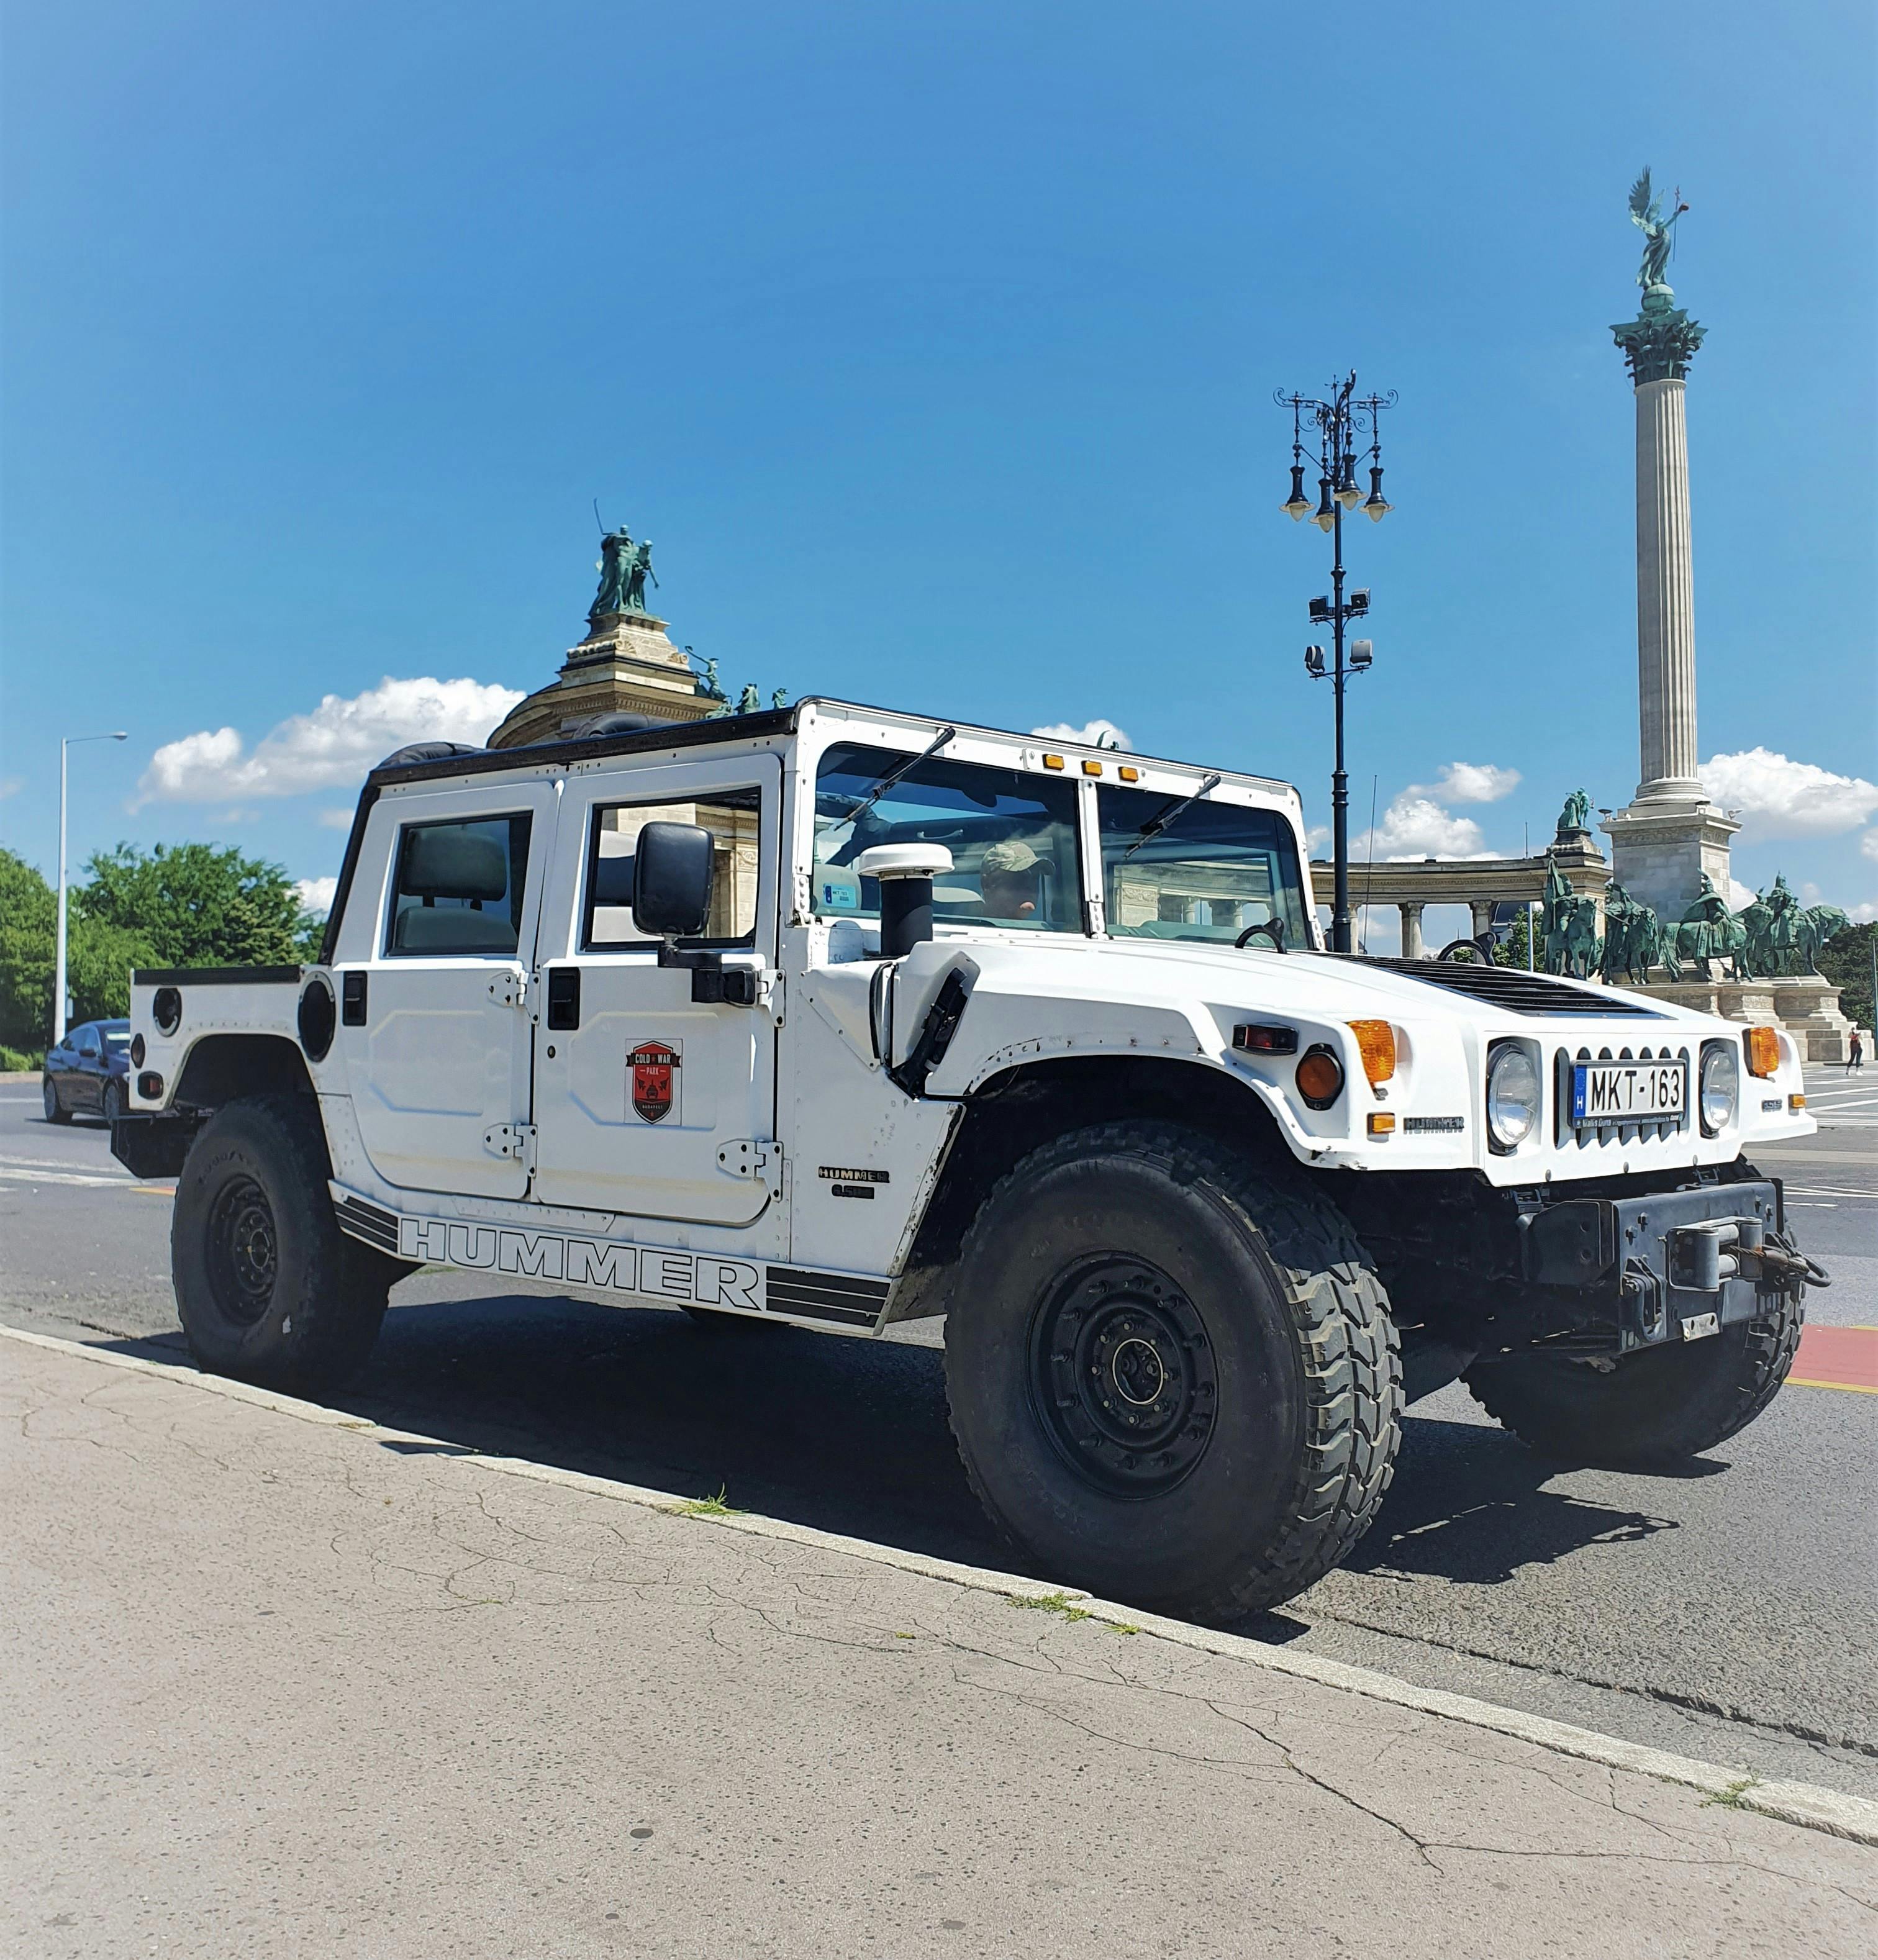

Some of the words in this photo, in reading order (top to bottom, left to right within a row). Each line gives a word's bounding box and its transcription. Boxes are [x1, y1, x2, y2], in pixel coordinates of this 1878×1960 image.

[635, 1054, 650, 1064] COLD
[657, 1054, 671, 1064] WAR
[646, 1066, 660, 1076] PARK
[1590, 1068, 1679, 1112] MKT-163
[1576, 1096, 1583, 1110] H
[819, 1166, 889, 1183] HUMMER
[400, 1217, 763, 1311] HUMMER
